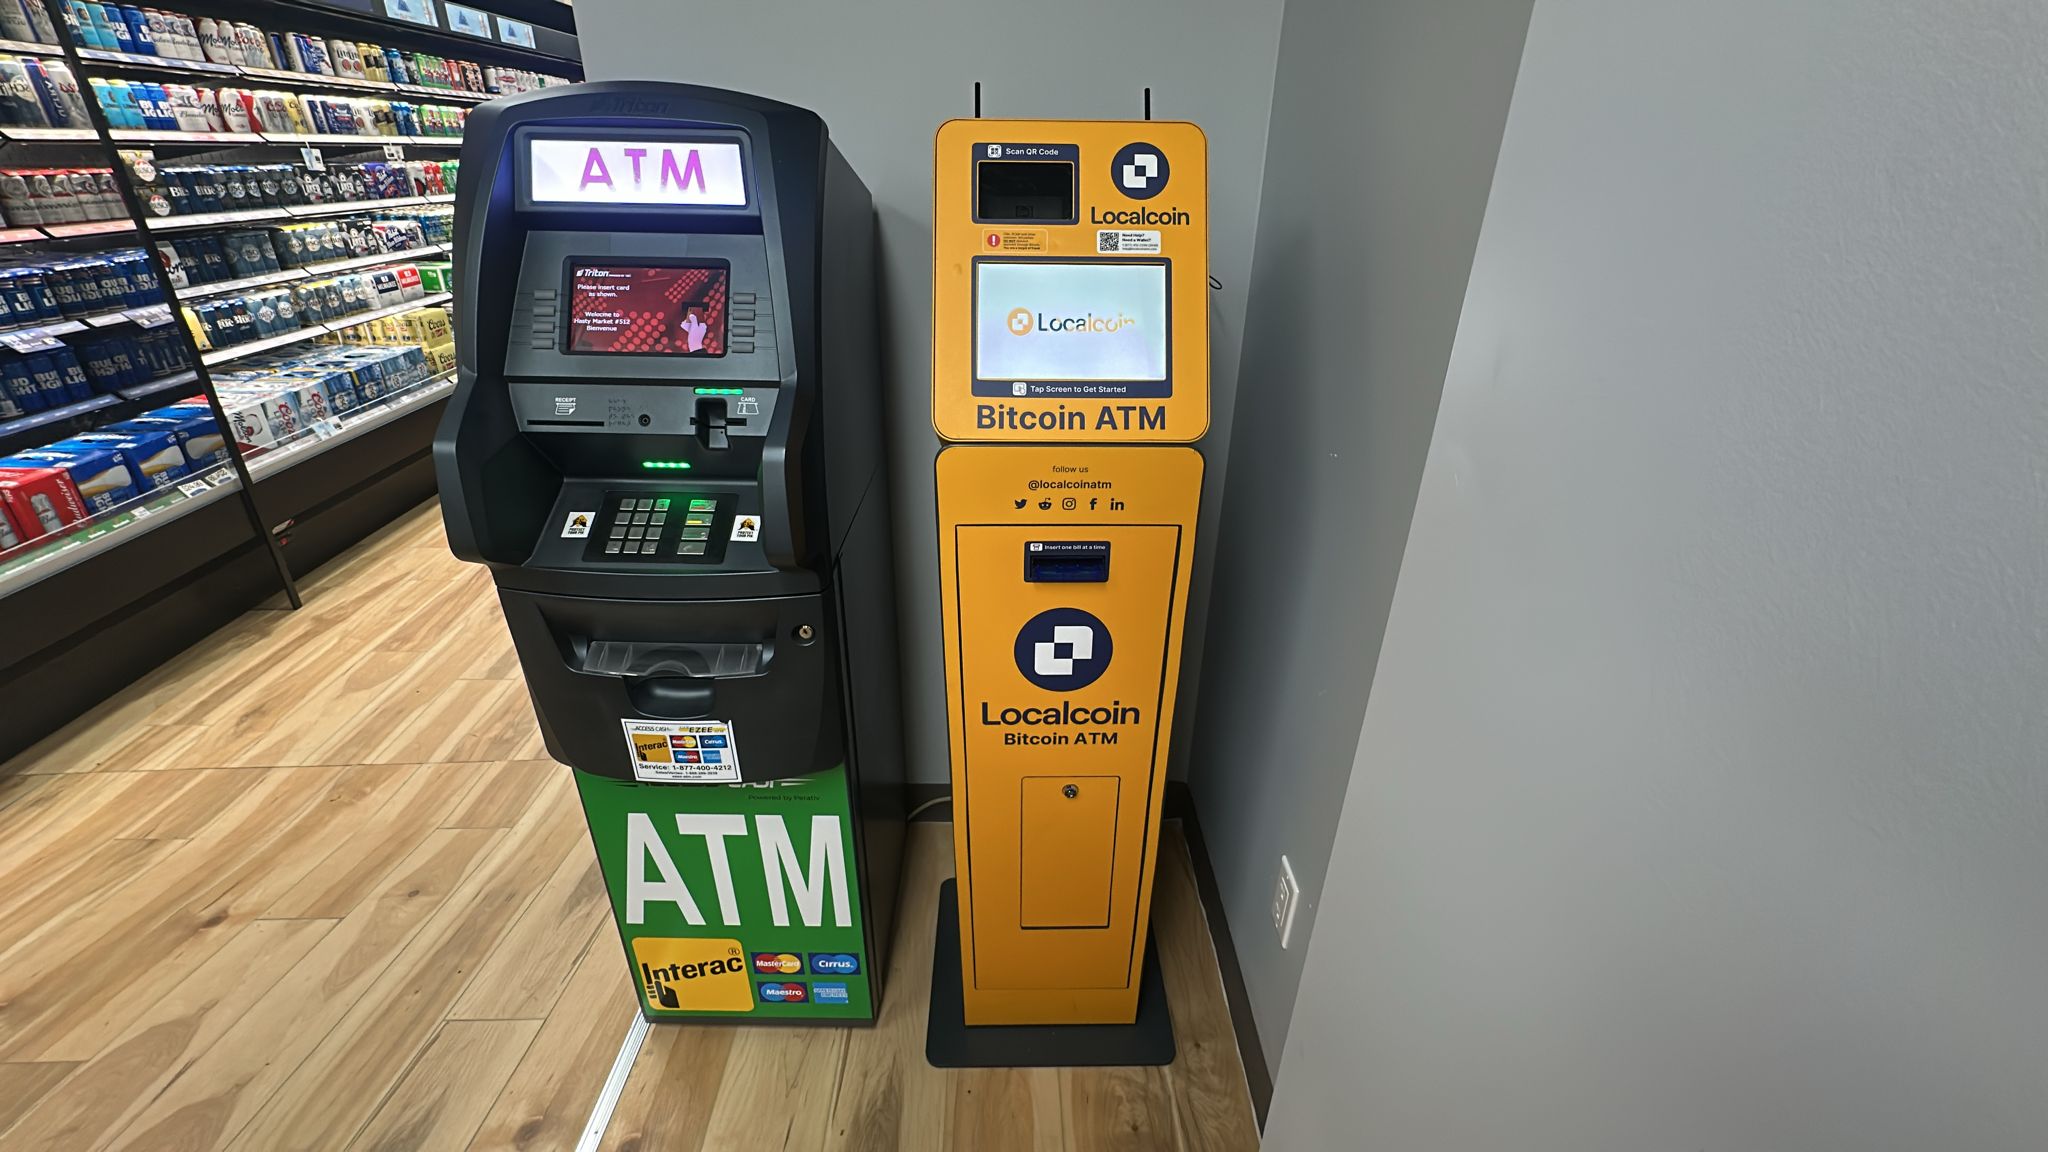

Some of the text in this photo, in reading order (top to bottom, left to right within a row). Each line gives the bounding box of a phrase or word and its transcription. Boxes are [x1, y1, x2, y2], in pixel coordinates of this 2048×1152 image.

[1005, 148, 1059, 156] Scan QR Code
[578, 147, 706, 193] ATM
[1091, 207, 1190, 226] Localcoin
[584, 269, 609, 277] Triton
[1038, 313, 1136, 332] Localcoin
[1030, 386, 1044, 394] Tap
[977, 404, 1166, 430] Bitcoin ATM
[1052, 465, 1076, 473] follow
[1028, 479, 1112, 491] @localcoinatm
[982, 701, 1140, 726] Localcoin
[1004, 732, 1118, 745] Bitcoin ATM
[635, 741, 669, 753] Interac
[626, 812, 852, 927] ATM
[756, 960, 800, 968] MasterCard
[818, 960, 851, 968] Cirrus
[641, 955, 744, 986] Interac
[766, 988, 802, 996] Maestro
